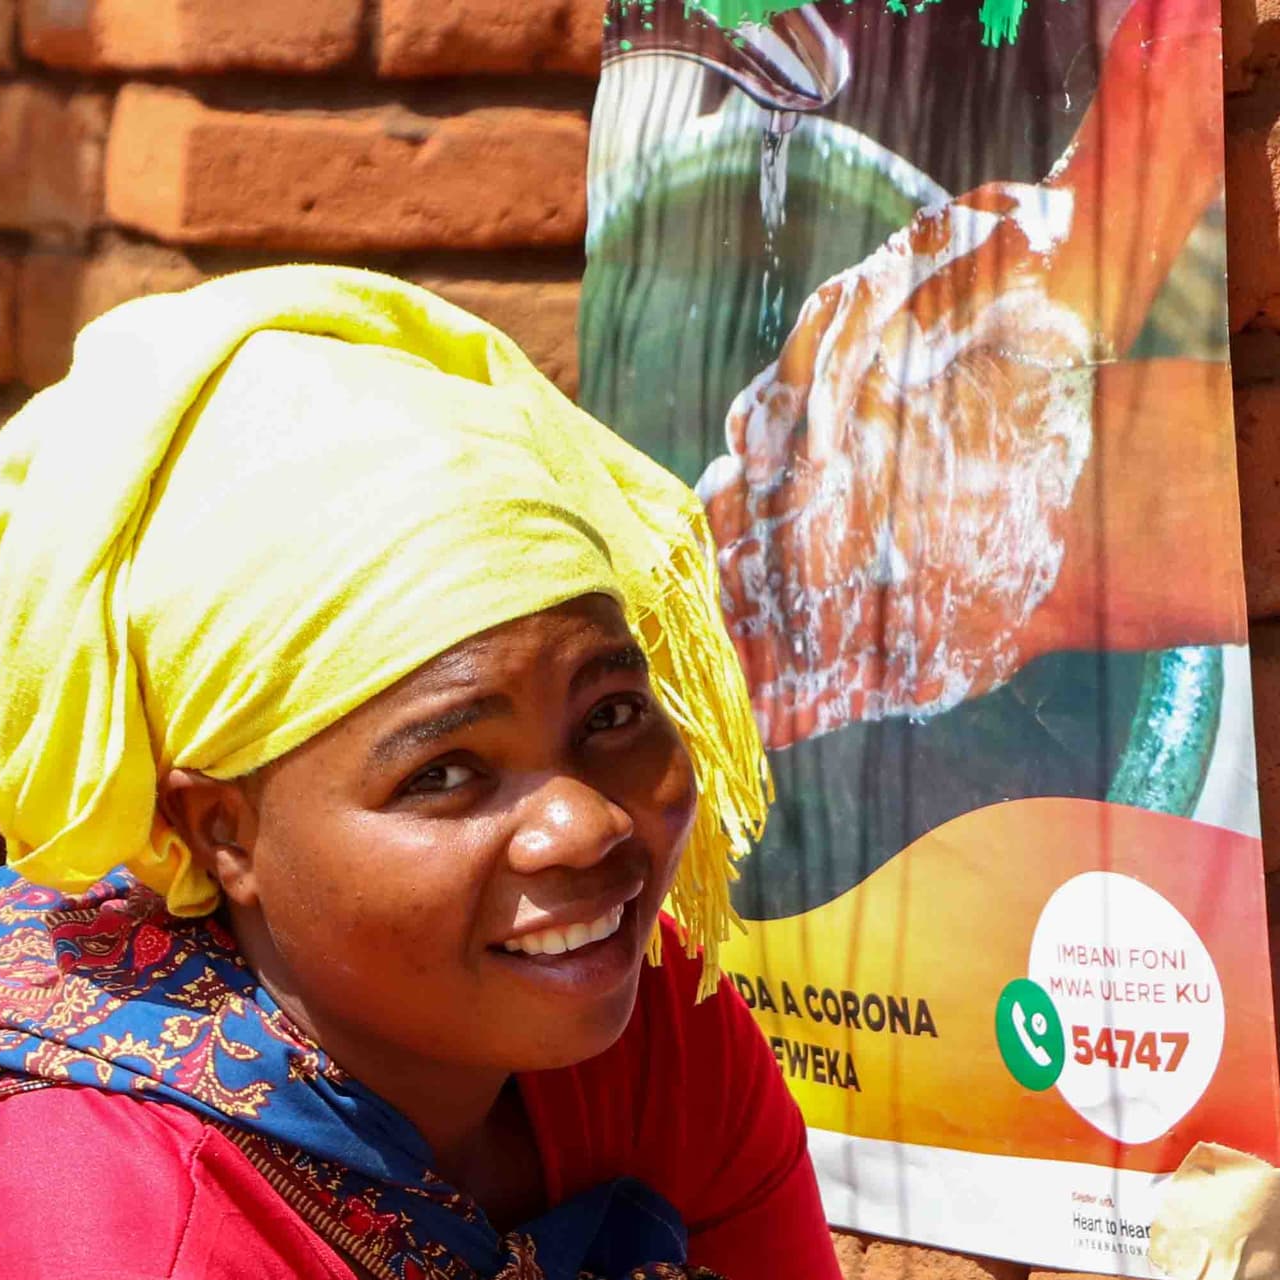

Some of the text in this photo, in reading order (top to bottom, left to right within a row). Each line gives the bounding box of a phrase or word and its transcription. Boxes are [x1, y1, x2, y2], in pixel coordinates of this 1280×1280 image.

[1057, 944, 1186, 970] IMBANI FONI
[1049, 976, 1211, 1004] MWA ULERE KU
[728, 971, 938, 1038] DA A CORONA
[1071, 1024, 1190, 1073] 54747
[1073, 1212, 1151, 1239] Heart to Hear
